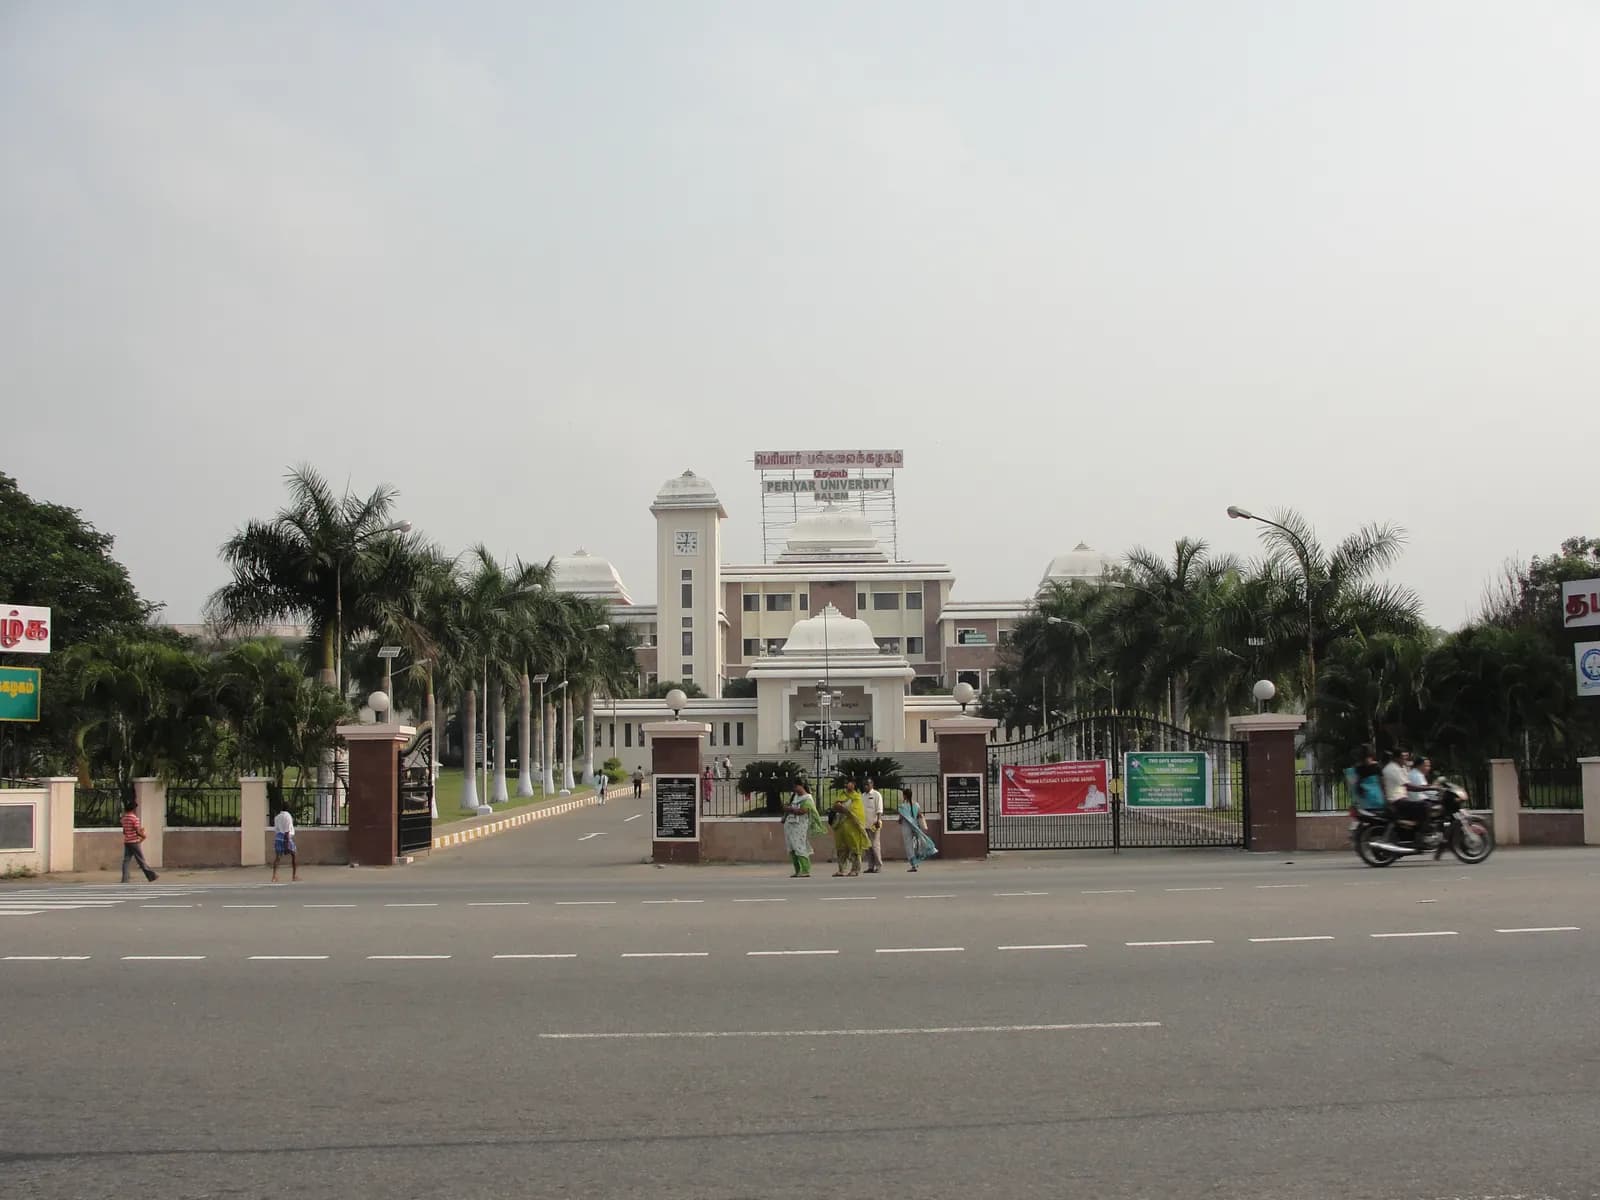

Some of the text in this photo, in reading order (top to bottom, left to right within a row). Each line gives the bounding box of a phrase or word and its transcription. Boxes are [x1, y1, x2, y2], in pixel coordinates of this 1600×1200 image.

[754, 450, 902, 468] பெரியார் பல்கலைக்கழகம்
[767, 479, 889, 492] PERIYAR UNIVERSITY
[814, 492, 849, 501] SALEM
